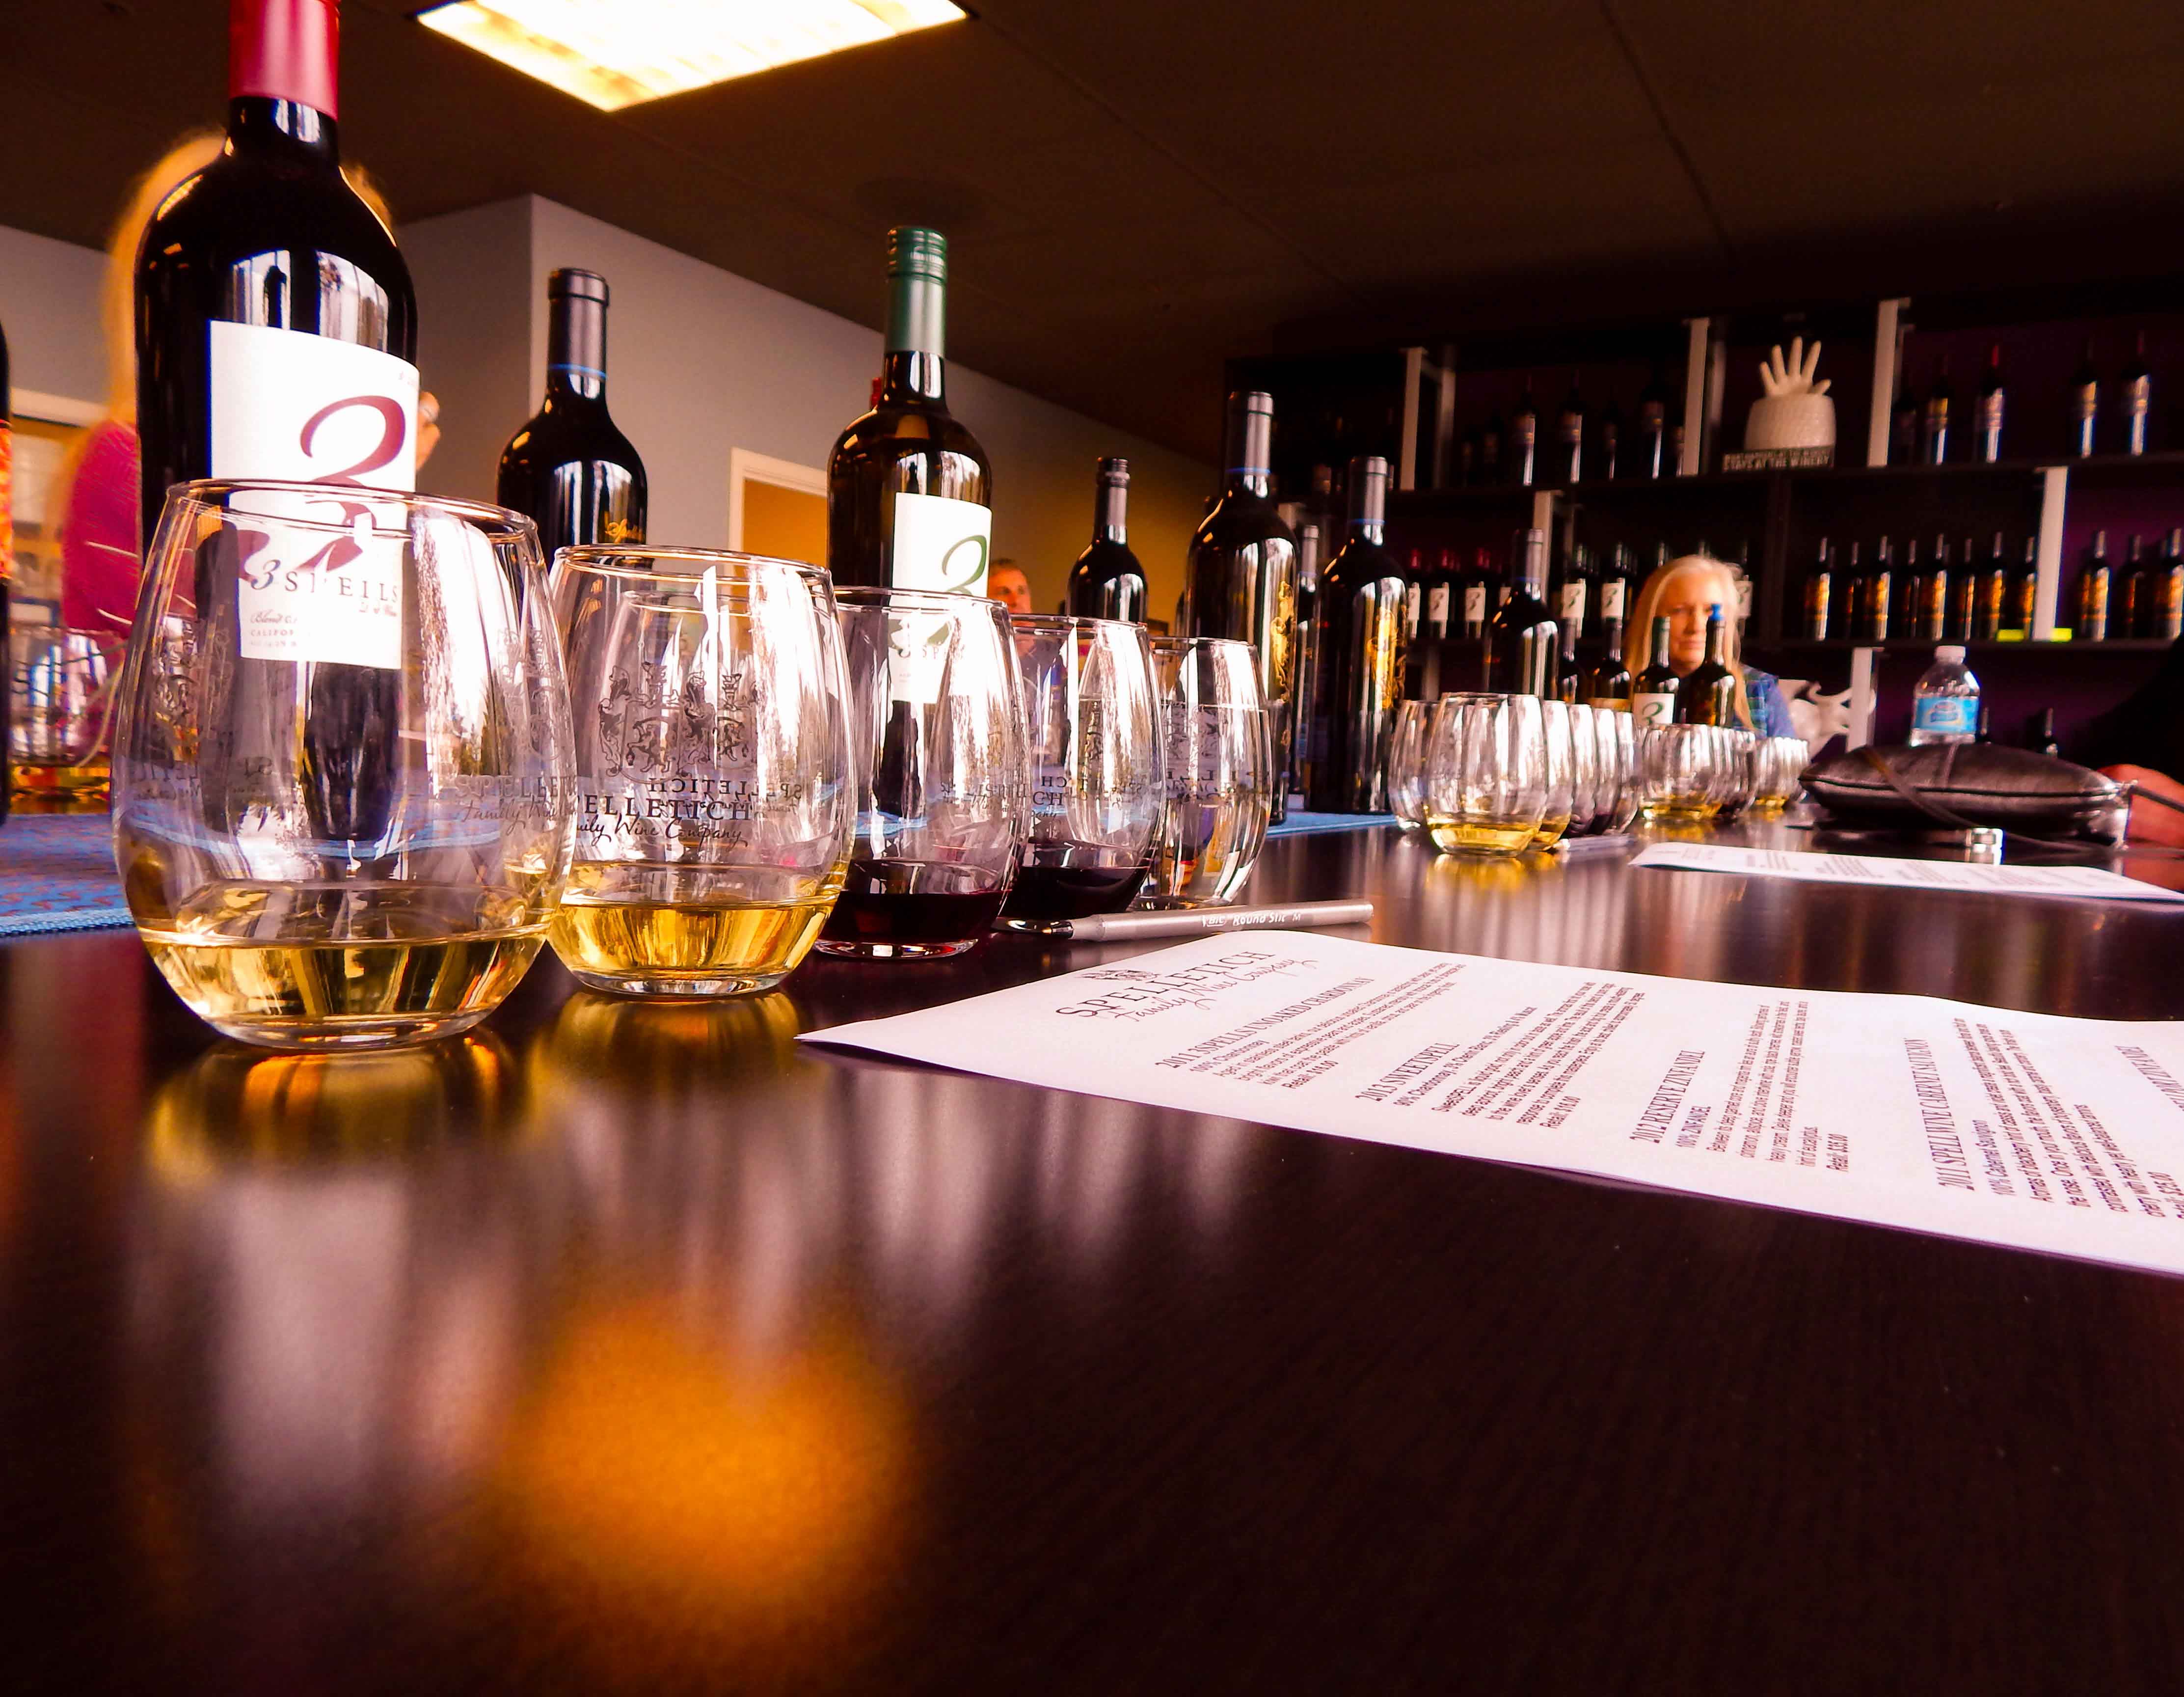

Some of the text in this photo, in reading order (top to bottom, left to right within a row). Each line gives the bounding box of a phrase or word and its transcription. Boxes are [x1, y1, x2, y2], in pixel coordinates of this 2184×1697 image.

[1769, 457, 1786, 468] THE
[1790, 455, 1830, 468] WINERY
[615, 812, 659, 836] Wine
[1233, 914, 1266, 926] Round
[1055, 951, 1276, 1018] SPELLETICH
[1155, 1053, 1202, 1068] 2011
[1242, 1005, 1312, 1030] UNOAKED
[1300, 977, 1375, 1006] CHARDONNAY
[1355, 1043, 1460, 1102] 2013 SWEETSPELL
[1629, 1050, 1705, 1144] 2012 RESERVE ZINFANDEL
[1903, 1038, 1975, 1191] 2011 SPELLWINE CABERNET SAUVIGNON
[1979, 1148, 2009, 1177] Cabernet
